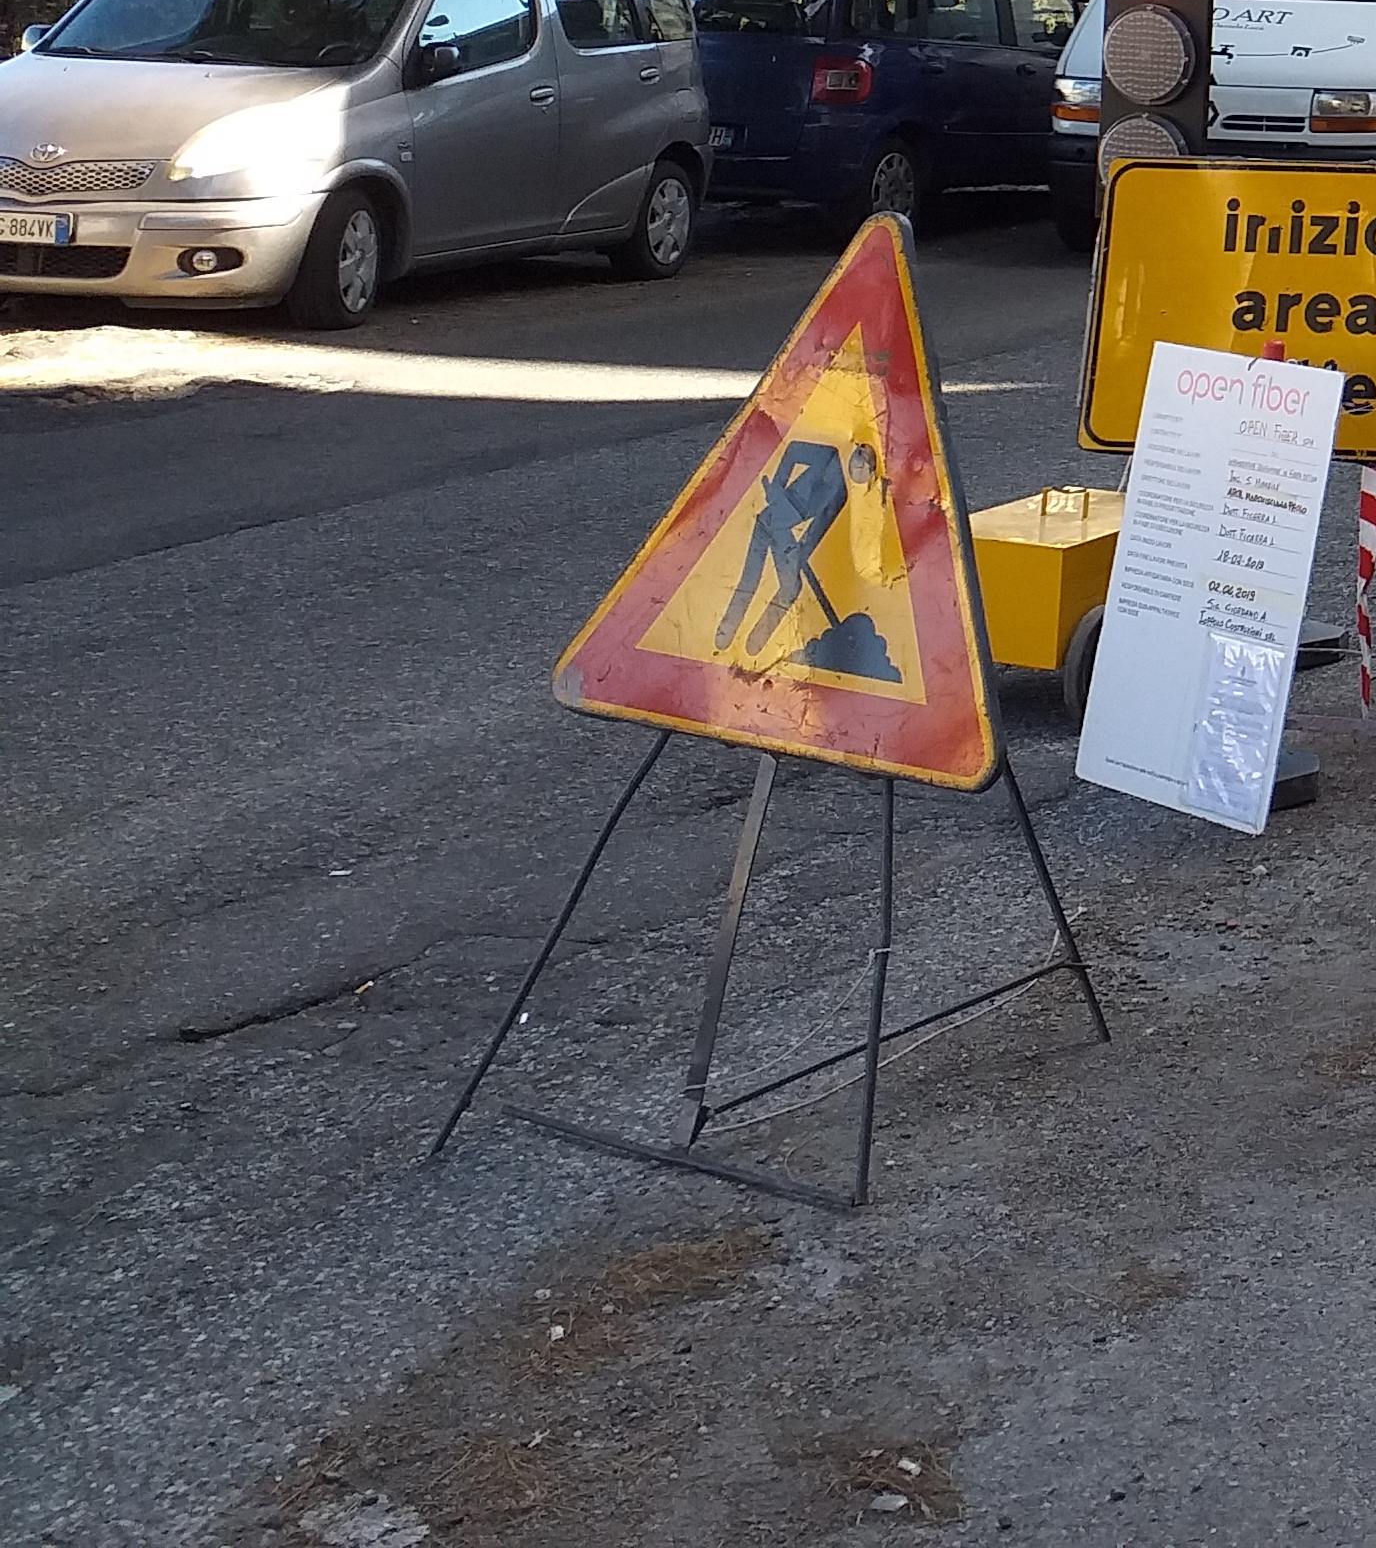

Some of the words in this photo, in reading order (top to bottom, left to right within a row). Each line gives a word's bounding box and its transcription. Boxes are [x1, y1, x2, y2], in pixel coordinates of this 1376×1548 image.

[1231, 9, 1294, 25] ART
[10, 218, 53, 237] 884VK
[1177, 370, 1244, 405] open
[1251, 374, 1310, 416] fiber
[1240, 420, 1267, 437] OPEN
